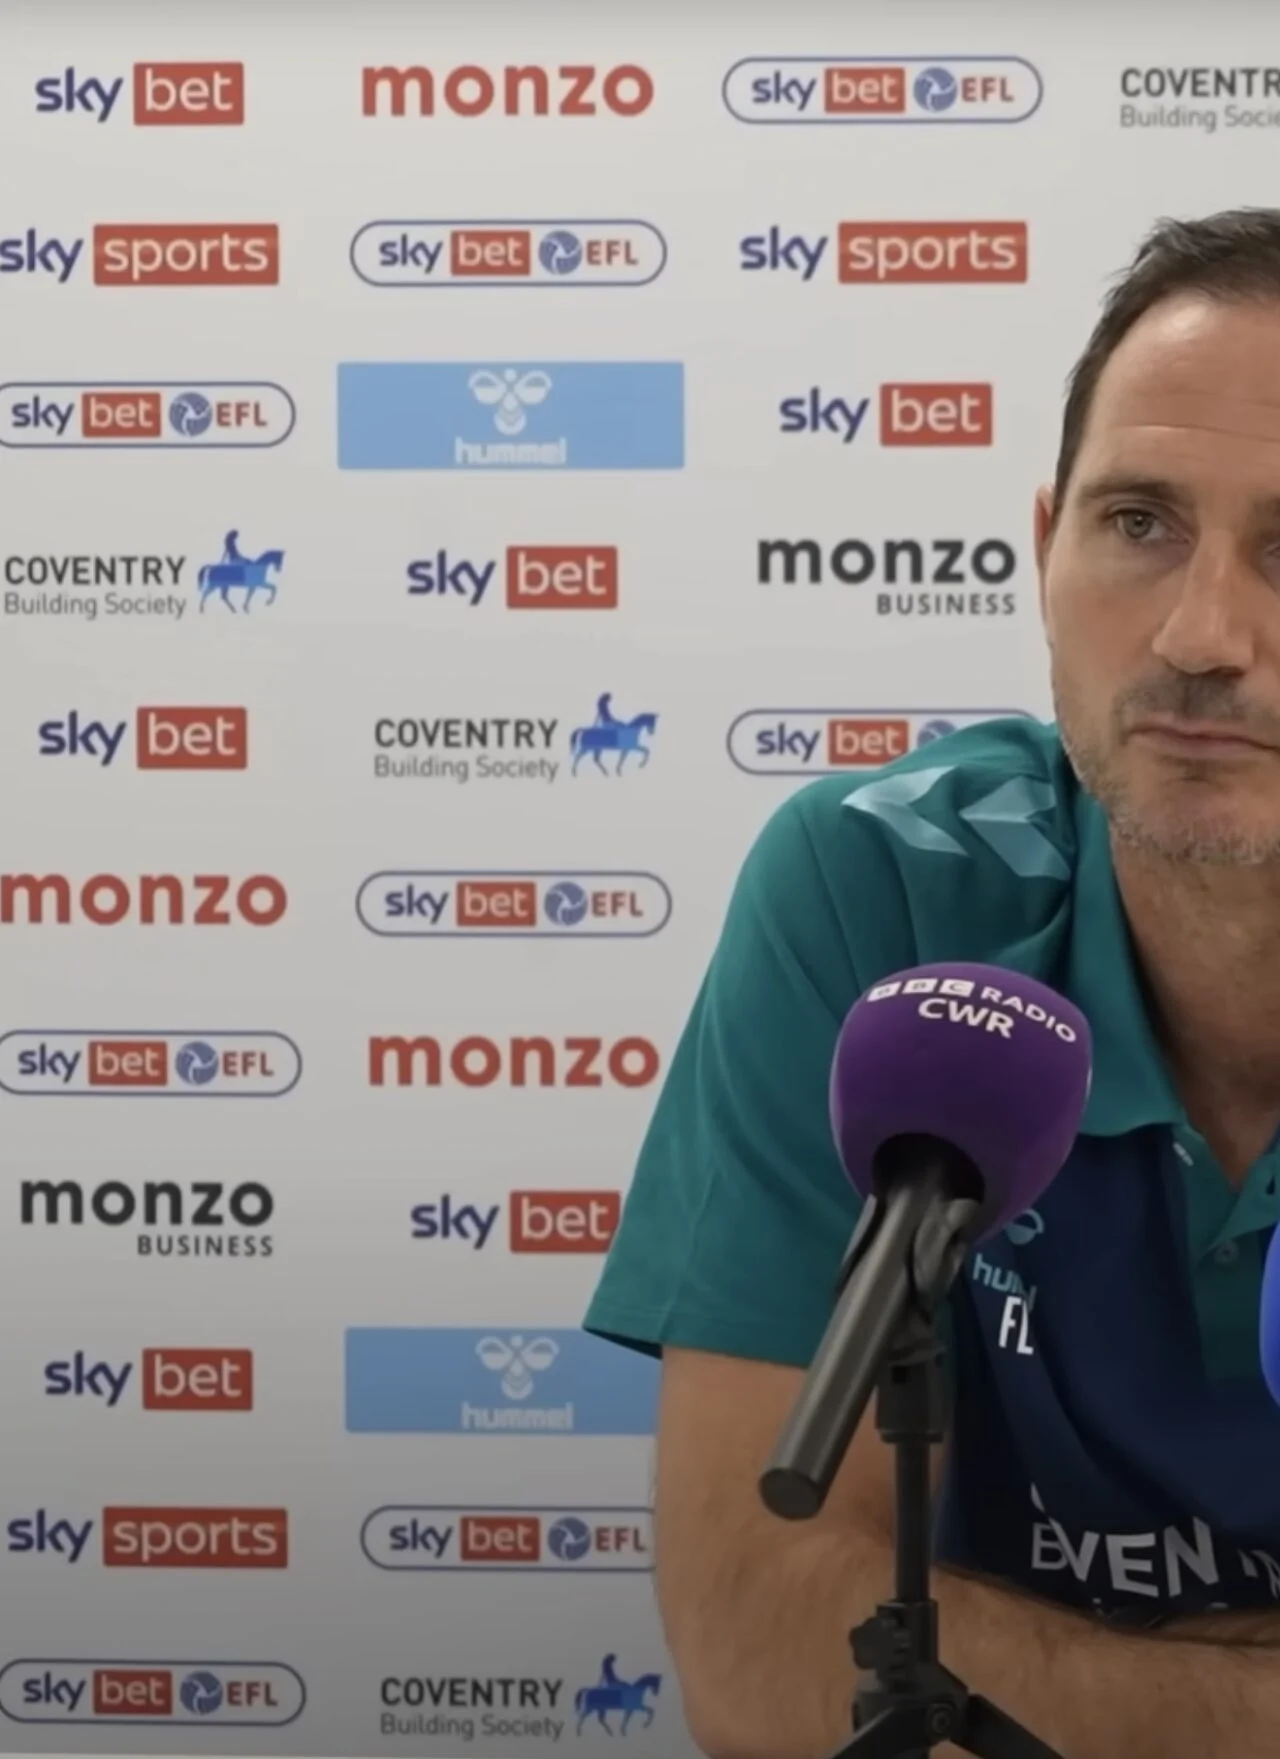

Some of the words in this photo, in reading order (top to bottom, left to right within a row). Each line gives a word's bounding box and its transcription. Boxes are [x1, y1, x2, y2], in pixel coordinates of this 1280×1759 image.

[36, 67, 123, 122] sky
[146, 68, 232, 111] bet
[362, 65, 653, 117] monzo
[752, 71, 816, 111] sky
[833, 72, 896, 103] bet
[961, 77, 1013, 102] EFL
[1120, 104, 1217, 133] Building
[0, 228, 83, 283] sky
[104, 233, 268, 280] sports
[379, 234, 443, 274] sky
[459, 235, 521, 265] bet
[586, 240, 638, 265] EFL
[740, 226, 828, 280] sky
[848, 231, 1016, 279] sports
[12, 396, 74, 435] sky
[90, 397, 152, 427] bet
[216, 402, 267, 427] EFL
[780, 387, 869, 443] sky
[892, 389, 980, 432] bet
[456, 439, 566, 465] hummel
[5, 556, 185, 585] COVENTRY
[407, 550, 496, 605] sky
[518, 552, 606, 594] bet
[758, 539, 1016, 584] monzo
[4, 592, 97, 621] Building
[105, 592, 186, 620] Society
[877, 593, 1015, 615] BUSINESS
[39, 710, 126, 766] sky
[149, 713, 235, 755] bet
[375, 719, 557, 748] COVENTRY
[756, 723, 820, 763] sky
[836, 725, 900, 755] bet
[374, 754, 469, 784] Building
[476, 754, 559, 783] Society
[0, 874, 287, 926] monzo
[385, 884, 448, 924] sky
[465, 886, 527, 916] bet
[591, 891, 643, 917] EFL
[918, 998, 1015, 1039] CWR
[980, 987, 1077, 1043] RADIO
[18, 1043, 81, 1083] sky
[97, 1045, 158, 1076] bet
[222, 1051, 273, 1076] EFL
[369, 1036, 659, 1088] monzo
[21, 1181, 273, 1226] monzo
[411, 1194, 499, 1250] sky
[522, 1197, 608, 1239] bet
[138, 1235, 272, 1257] BUSINESS
[999, 1295, 1034, 1355] FL
[45, 1351, 132, 1406] sky
[155, 1354, 241, 1396] bet
[462, 1403, 573, 1429] hummel
[8, 1509, 93, 1563] sky
[113, 1518, 276, 1561] sports
[390, 1519, 452, 1558] sky
[468, 1521, 530, 1551] bet
[595, 1527, 647, 1553] EFL
[23, 1672, 86, 1711] sky
[101, 1674, 163, 1704] bet
[227, 1681, 277, 1706] EFL
[381, 1678, 562, 1707] COVENTRY
[381, 1712, 475, 1741] Building
[481, 1713, 565, 1743] Society
